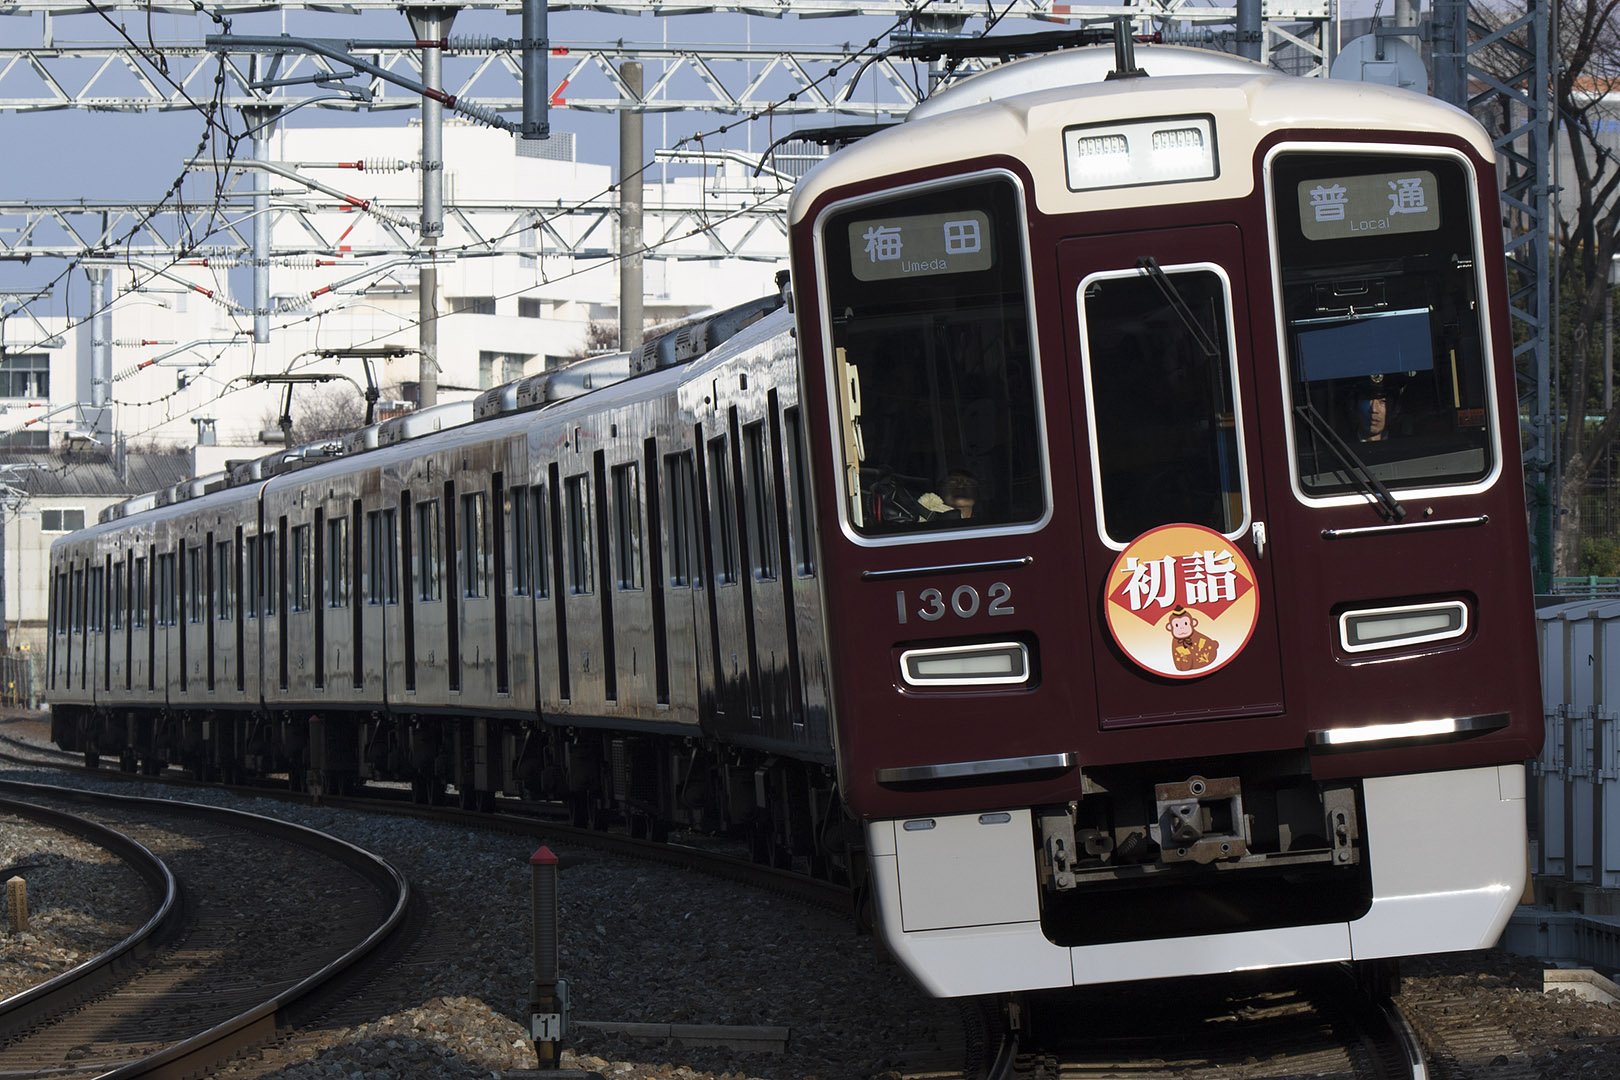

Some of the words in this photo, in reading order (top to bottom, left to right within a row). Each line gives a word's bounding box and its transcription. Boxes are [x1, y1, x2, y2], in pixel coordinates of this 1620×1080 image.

[1309, 177, 1428, 222] 普通
[862, 219, 981, 263] 梅田
[1350, 217, 1390, 232] Local
[901, 258, 948, 273] Umeda
[1120, 549, 1238, 611] 初詣
[896, 582, 1015, 625] 1302
[541, 1017, 549, 1038] 1
